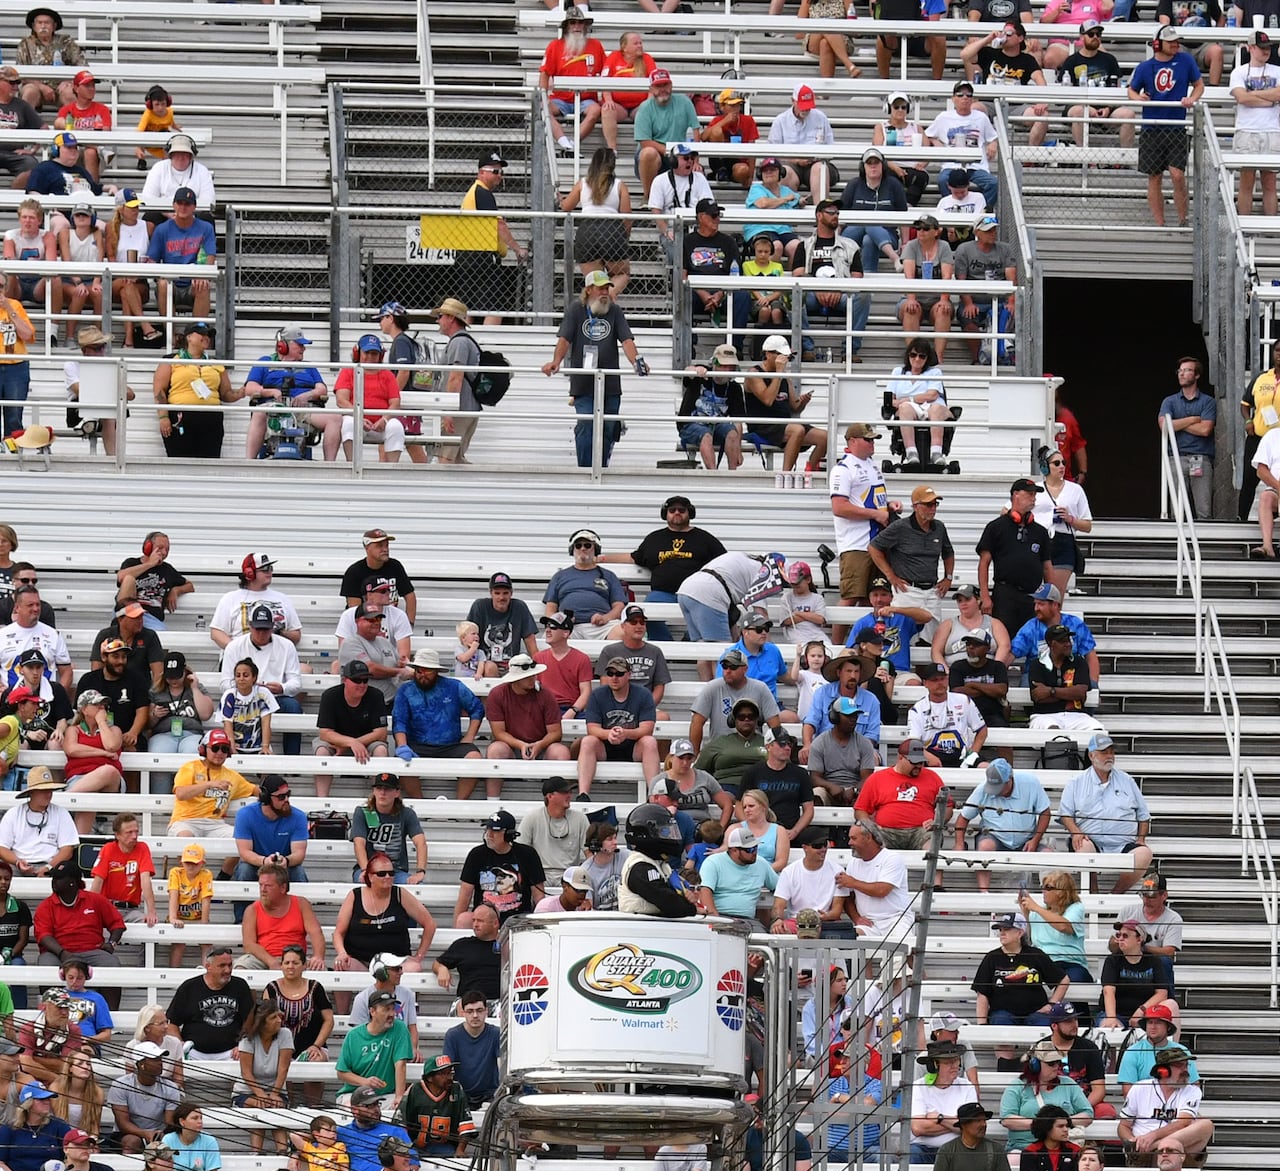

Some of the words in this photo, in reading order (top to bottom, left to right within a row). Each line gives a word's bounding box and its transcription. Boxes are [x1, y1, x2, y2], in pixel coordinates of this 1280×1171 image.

[3, 332, 17, 346] 18
[167, 660, 178, 668] 20
[644, 657, 654, 667] 66
[368, 823, 395, 844] 88
[125, 860, 137, 874] 18
[604, 954, 654, 971] QUAKER
[607, 963, 645, 978] STATE
[641, 968, 692, 989] 400
[1026, 973, 1039, 984] 24
[68, 1001, 94, 1015] SCH
[202, 996, 238, 1008] ATLANTA
[625, 999, 661, 1009] ATLANTA
[621, 1018, 664, 1029] Walmart
